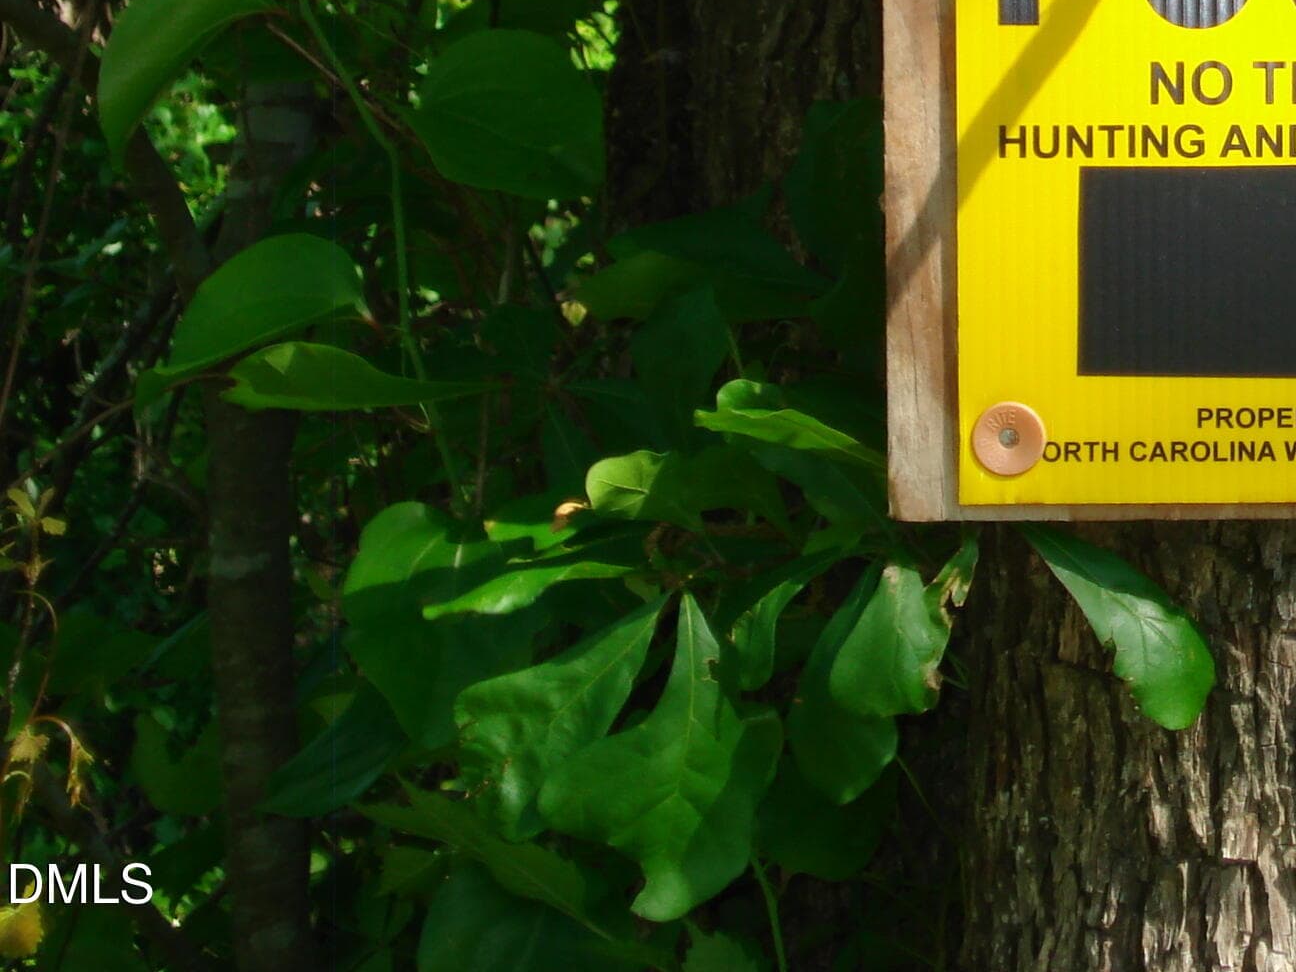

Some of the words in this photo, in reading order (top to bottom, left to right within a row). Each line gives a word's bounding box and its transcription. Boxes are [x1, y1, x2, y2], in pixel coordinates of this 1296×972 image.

[1150, 60, 1233, 106] NO
[998, 124, 1206, 159] HUNTING
[1042, 440, 1120, 463] ORTH
[1129, 440, 1276, 463] CAROLINA
